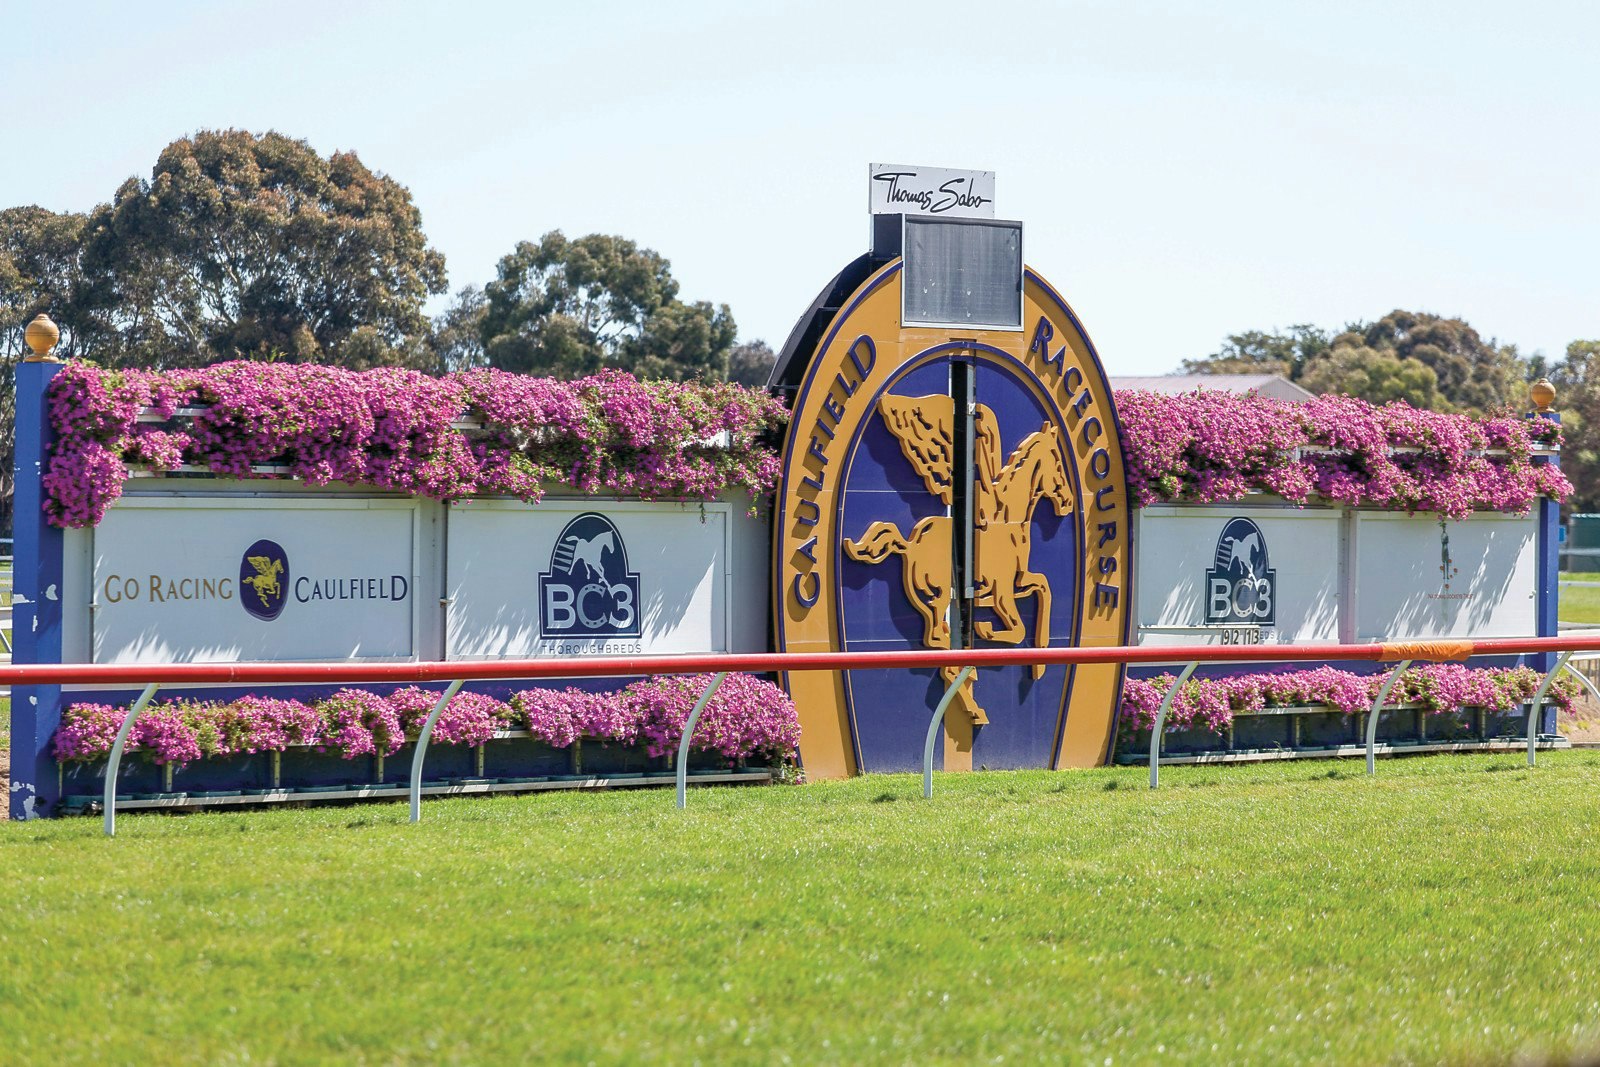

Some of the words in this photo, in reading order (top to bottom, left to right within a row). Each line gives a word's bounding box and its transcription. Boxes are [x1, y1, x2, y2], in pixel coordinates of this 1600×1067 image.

[873, 173, 933, 210] Thomas
[930, 178, 992, 212] Sabo
[795, 334, 877, 608] CAULFIELD
[1032, 316, 1119, 610] RACECOURSE
[295, 575, 408, 603] CAULFIELD
[545, 583, 635, 629] BC3
[1209, 578, 1271, 618] BC3
[541, 644, 642, 655] THOROUGHBREDS
